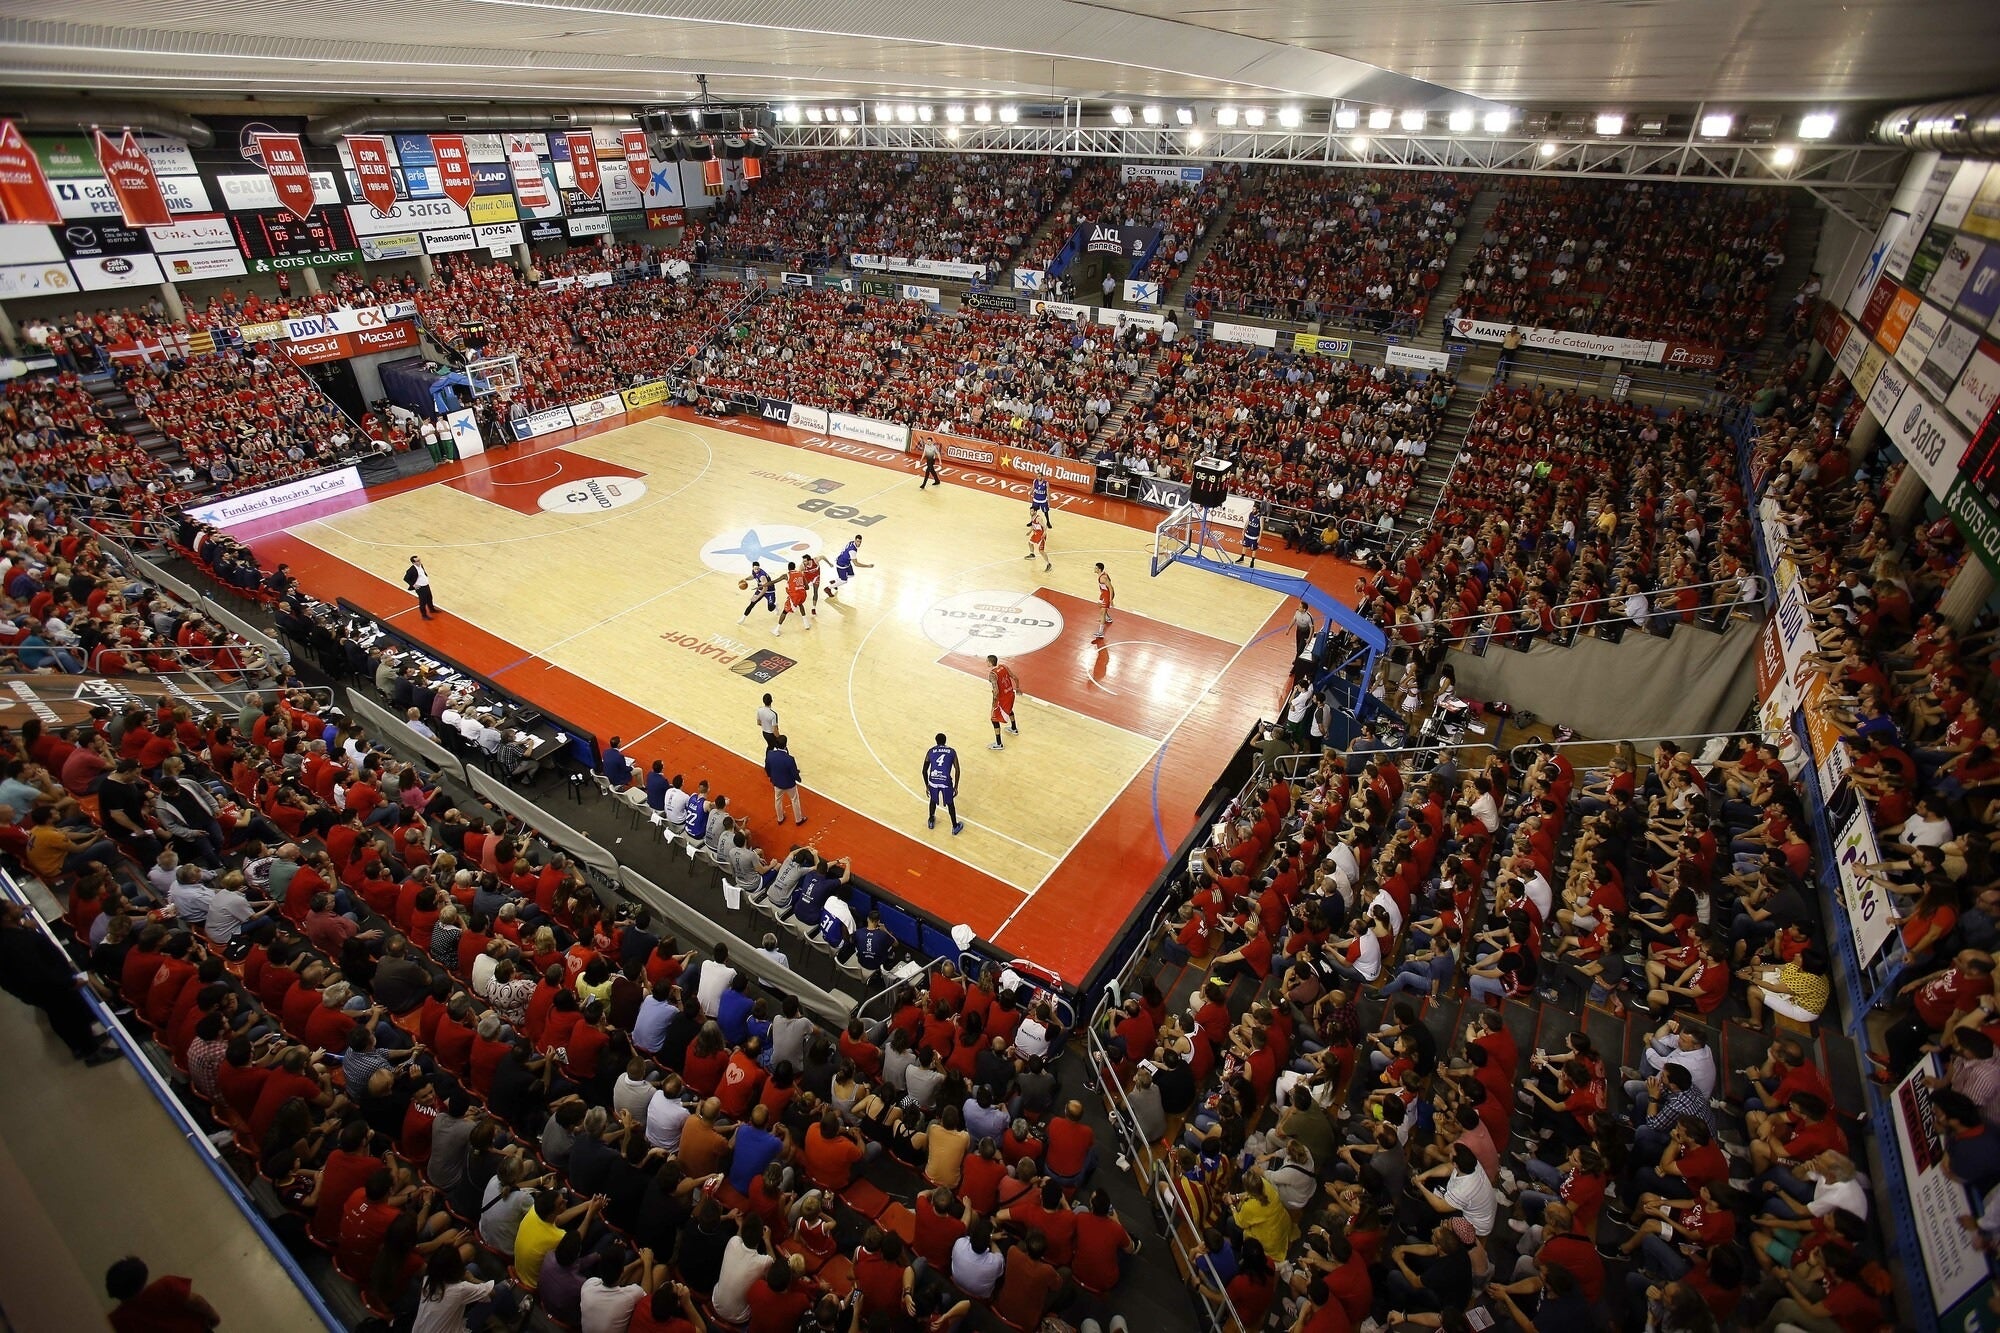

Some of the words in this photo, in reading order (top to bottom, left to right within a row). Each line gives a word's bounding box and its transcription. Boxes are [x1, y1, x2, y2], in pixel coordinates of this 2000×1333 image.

[271, 150, 295, 161] LLIGA
[360, 151, 380, 161] COPA
[439, 148, 462, 158] LLIGA
[270, 165, 307, 176] CATALANA
[360, 165, 375, 174] DEL
[375, 165, 387, 174] REI
[447, 162, 462, 172] LEB
[1140, 168, 1178, 176] CONTROL
[160, 181, 178, 195] de
[409, 201, 451, 217] sarsa
[660, 212, 682, 221] Estrella
[480, 224, 517, 236] JOYSAT
[570, 222, 583, 232] cal
[585, 220, 608, 231] manel
[275, 231, 289, 241] 05
[426, 231, 472, 244] Panasonic
[1088, 241, 1123, 255] MANRESA
[273, 258, 306, 268] COTS
[312, 252, 354, 265] CLARET
[356, 309, 382, 327] CX
[289, 316, 339, 338] BBVA
[358, 330, 394, 345] Macsa
[395, 327, 406, 338] id
[1475, 326, 1527, 342] MANRA
[1530, 333, 1546, 344] Cor
[1548, 334, 1560, 345] de
[1562, 336, 1615, 353] Catalunya
[287, 342, 325, 357] Macsa
[327, 339, 339, 350] id
[1688, 358, 1714, 366] 2022
[1912, 416, 1946, 467] sarsa
[947, 446, 994, 463] MANRESA
[802, 437, 900, 462] PAVELLÓ
[961, 471, 1095, 506] CONGST"
[1013, 455, 1052, 477] Estrella
[1055, 465, 1090, 485] Damm
[586, 479, 612, 509] CONTROL
[221, 499, 268, 519] Fundació
[270, 487, 310, 506] Bancària
[1960, 496, 1986, 534] COTS
[934, 608, 1055, 628] CONTROL
[659, 631, 739, 665] PLAYOFF
[936, 754, 946, 767] 4
[821, 914, 834, 933] 31
[1912, 1069, 1939, 1152] MANRESA
[1932, 1173, 1948, 1212] millor
[1922, 1184, 1931, 1202] de
[1927, 1203, 1953, 1281] proximitat
